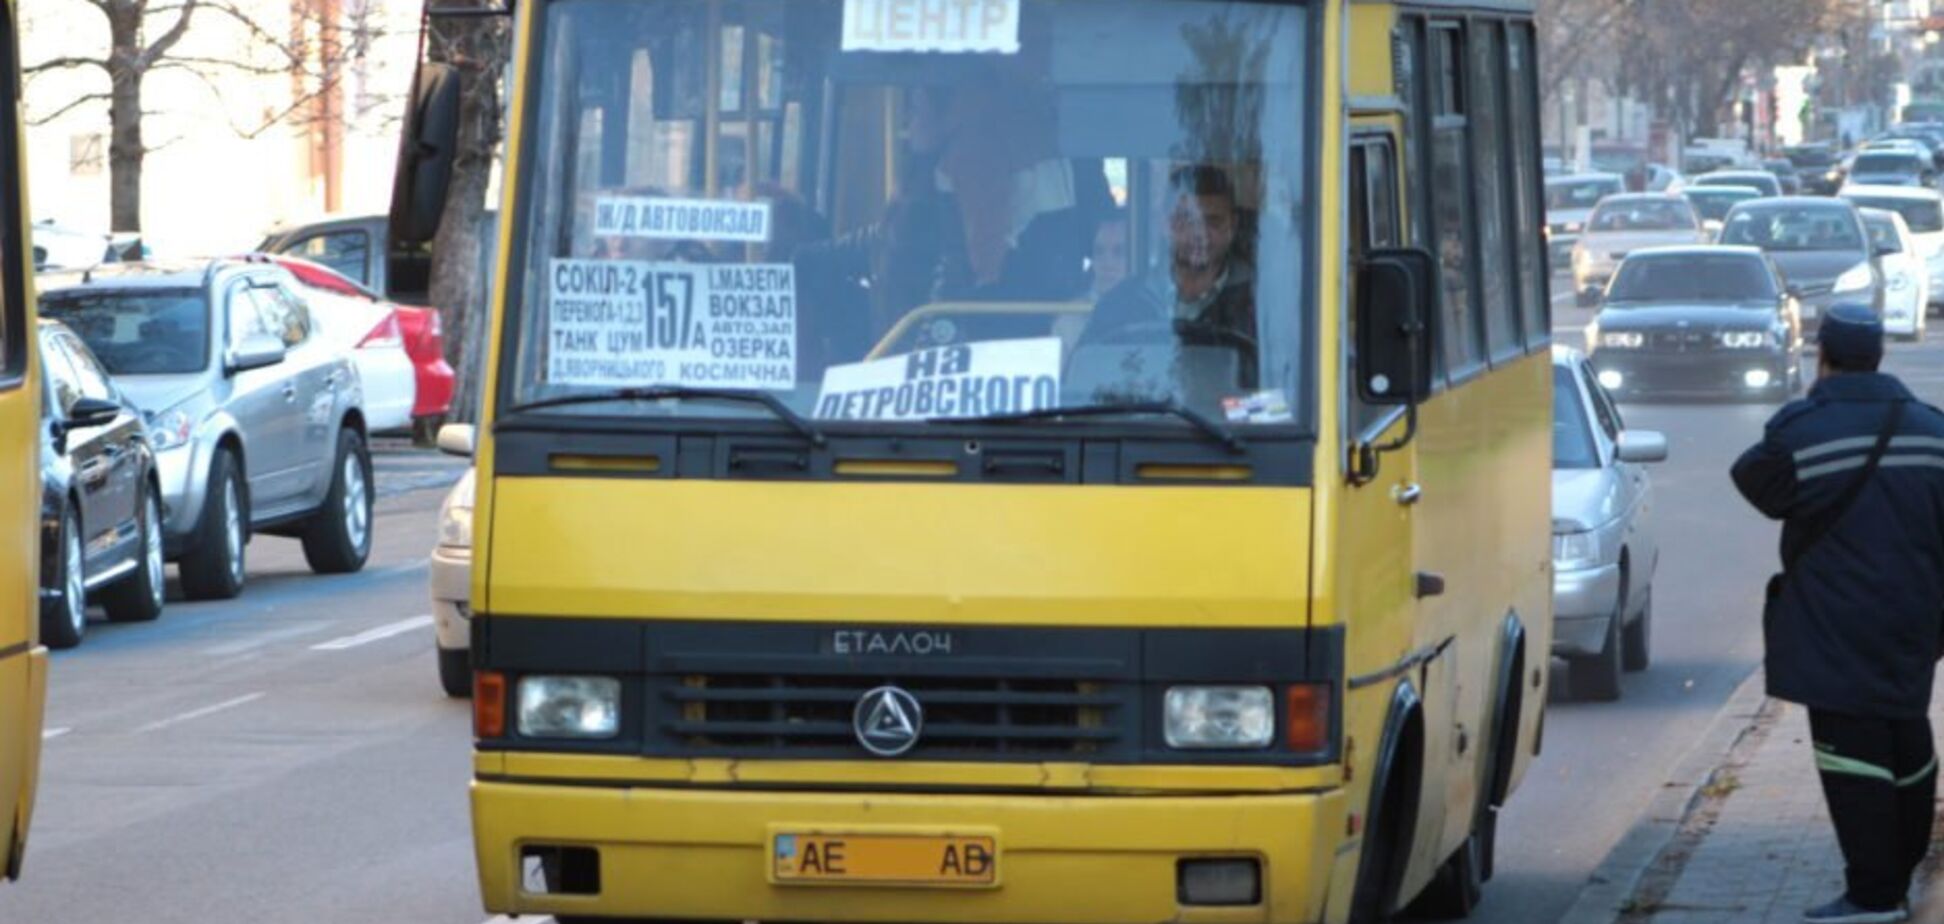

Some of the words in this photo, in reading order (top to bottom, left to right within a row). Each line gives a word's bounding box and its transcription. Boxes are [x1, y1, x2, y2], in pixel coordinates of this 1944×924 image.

[853, 0, 1008, 43] ЦЕНТР
[597, 203, 637, 232] Ж/Д
[640, 204, 764, 236] АВТОВОКЗАЛ
[555, 264, 638, 294] СОКІЛ-2
[641, 270, 694, 350] 157
[709, 294, 792, 318] ВОКЗАЛ
[554, 330, 599, 352] ТАНК
[607, 330, 643, 354] ЦУМ
[711, 337, 791, 359] ОЗЕРКА
[680, 362, 791, 381] КОСМІЧНА
[813, 374, 1058, 418] ПЕТРОВСКОГО
